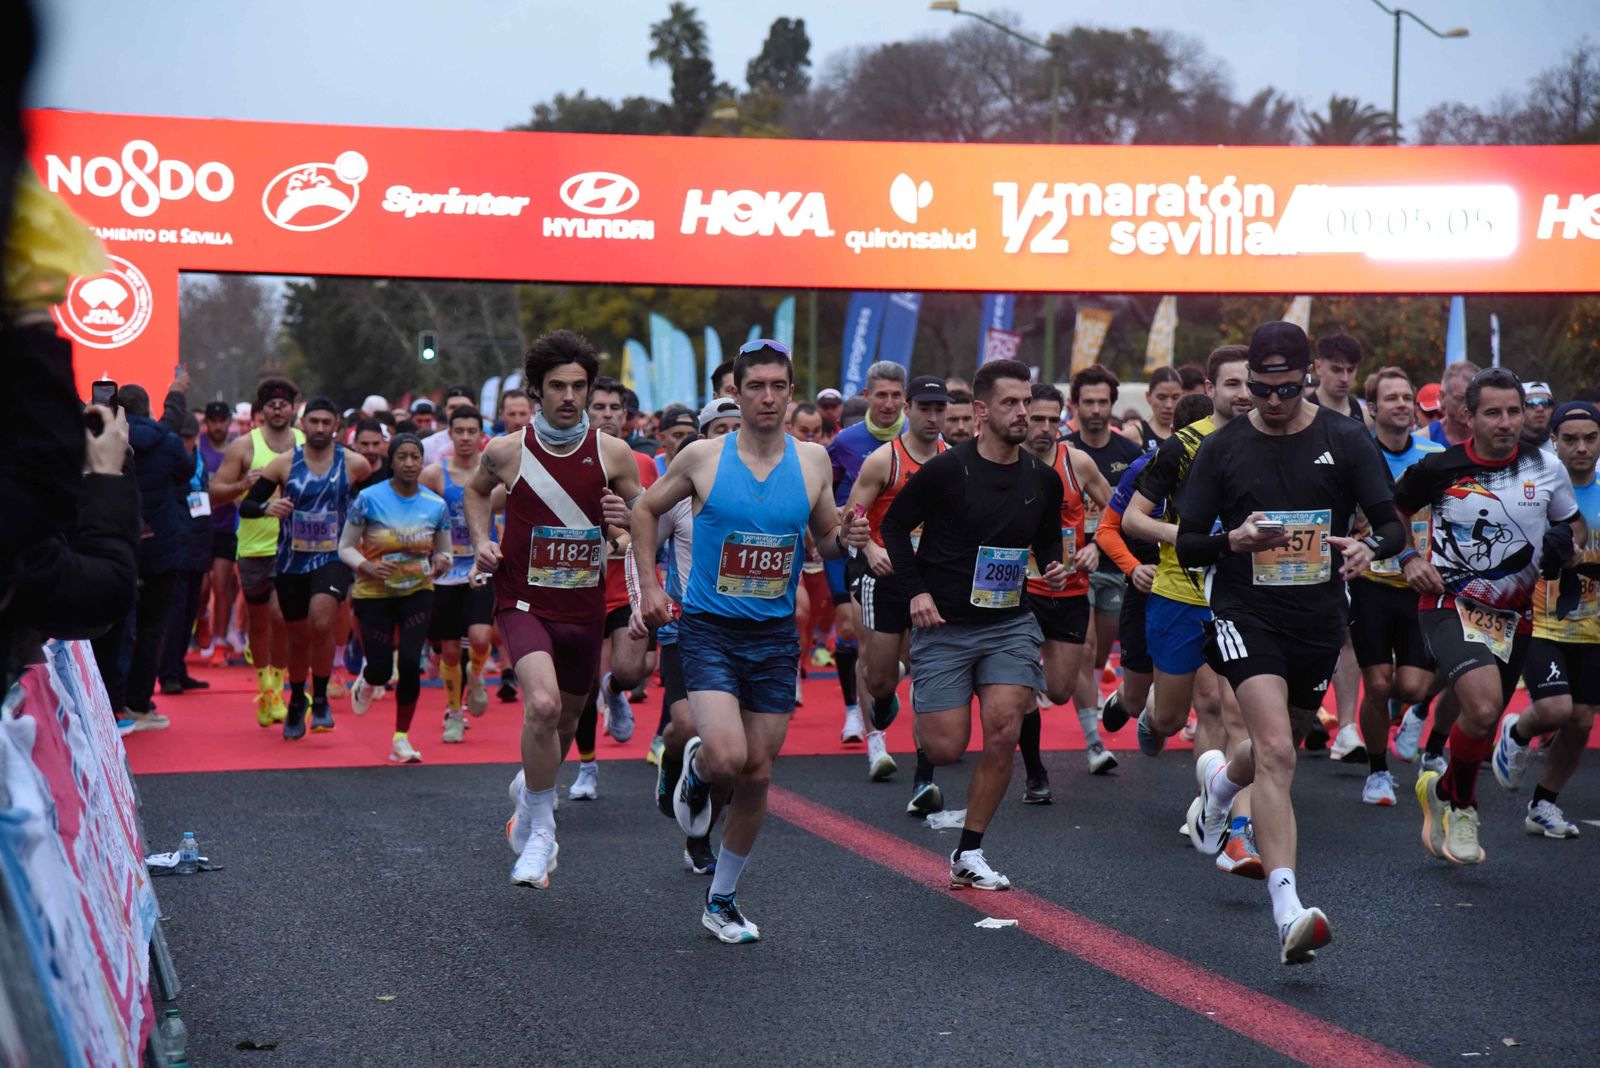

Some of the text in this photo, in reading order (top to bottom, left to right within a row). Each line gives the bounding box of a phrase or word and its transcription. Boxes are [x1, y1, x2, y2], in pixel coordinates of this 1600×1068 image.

[382, 185, 530, 218] Sprinter
[1054, 175, 1275, 217] maratón
[680, 189, 835, 238] HOKA
[1325, 207, 1494, 237] 00:05:05
[89, 226, 156, 242] AMIENTO
[158, 229, 178, 243] DE
[543, 217, 655, 240] HYUNDAI
[1108, 212, 1278, 256] sevilla
[299, 522, 328, 536] 3195
[456, 527, 470, 540] 29
[546, 542, 590, 561] 1182
[738, 549, 783, 571] 1183
[985, 563, 1020, 582] 2890
